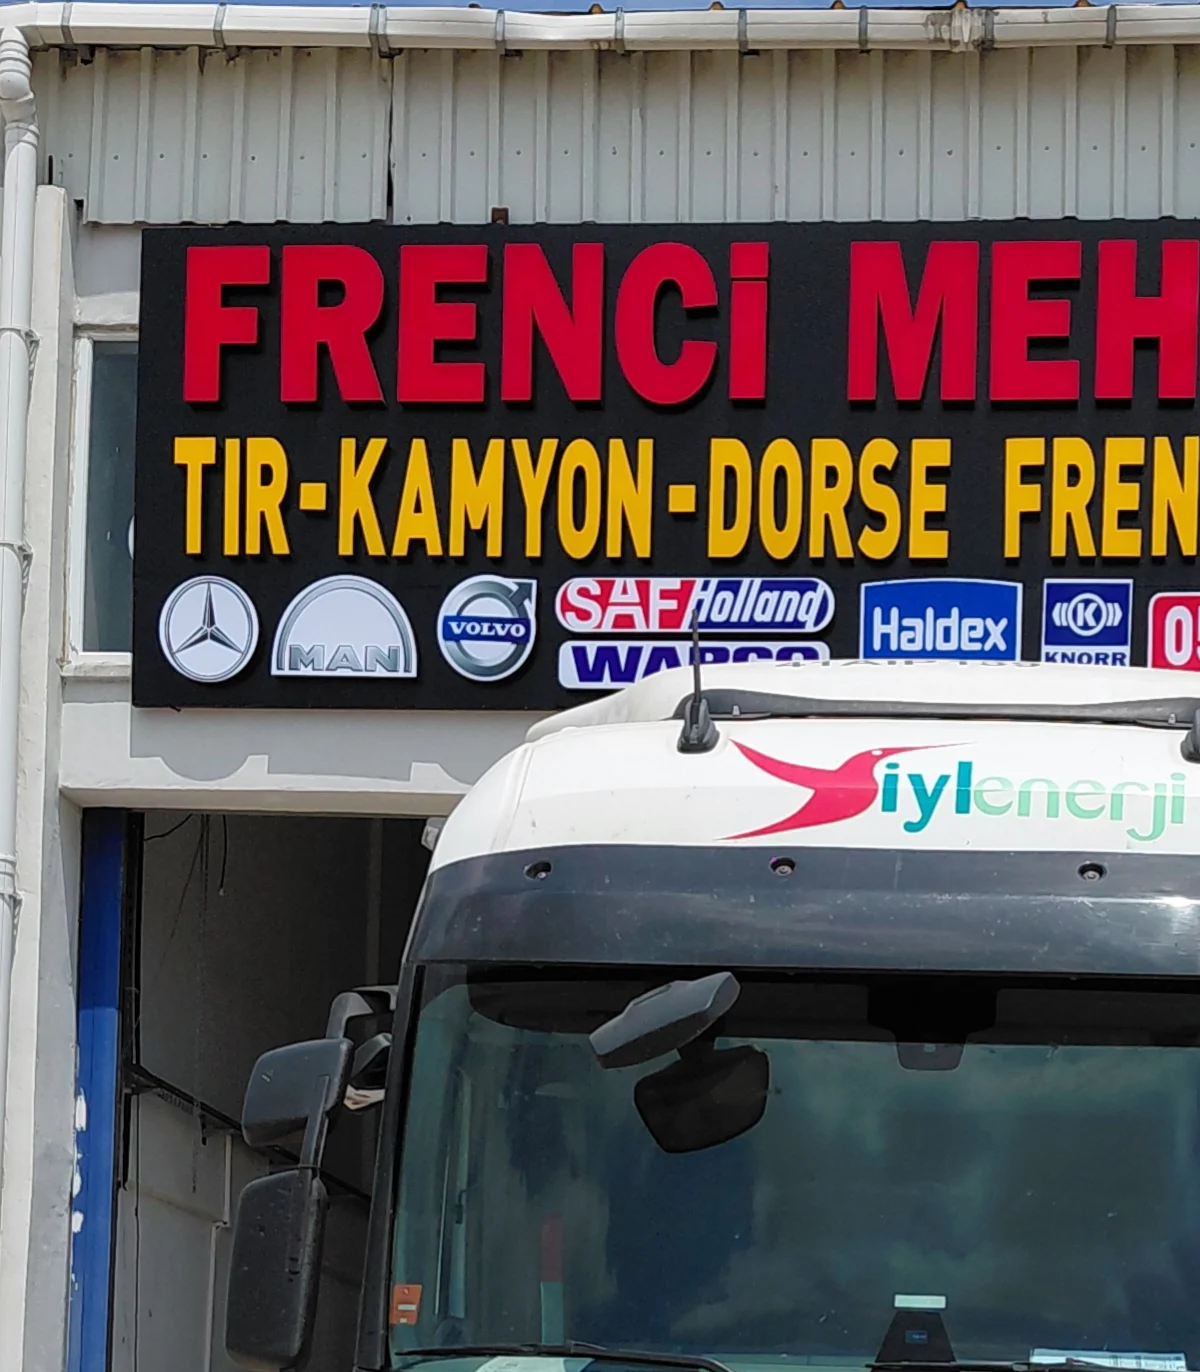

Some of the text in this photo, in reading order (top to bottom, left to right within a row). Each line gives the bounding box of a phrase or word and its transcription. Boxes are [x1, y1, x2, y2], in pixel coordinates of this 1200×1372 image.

[1004, 435, 1200, 558] FREN
[565, 579, 828, 629] SAF Holland
[448, 621, 526, 637] VOLVO
[873, 606, 1008, 651] Haldex
[288, 644, 400, 672] MAN
[1044, 651, 1127, 667] KNORR
